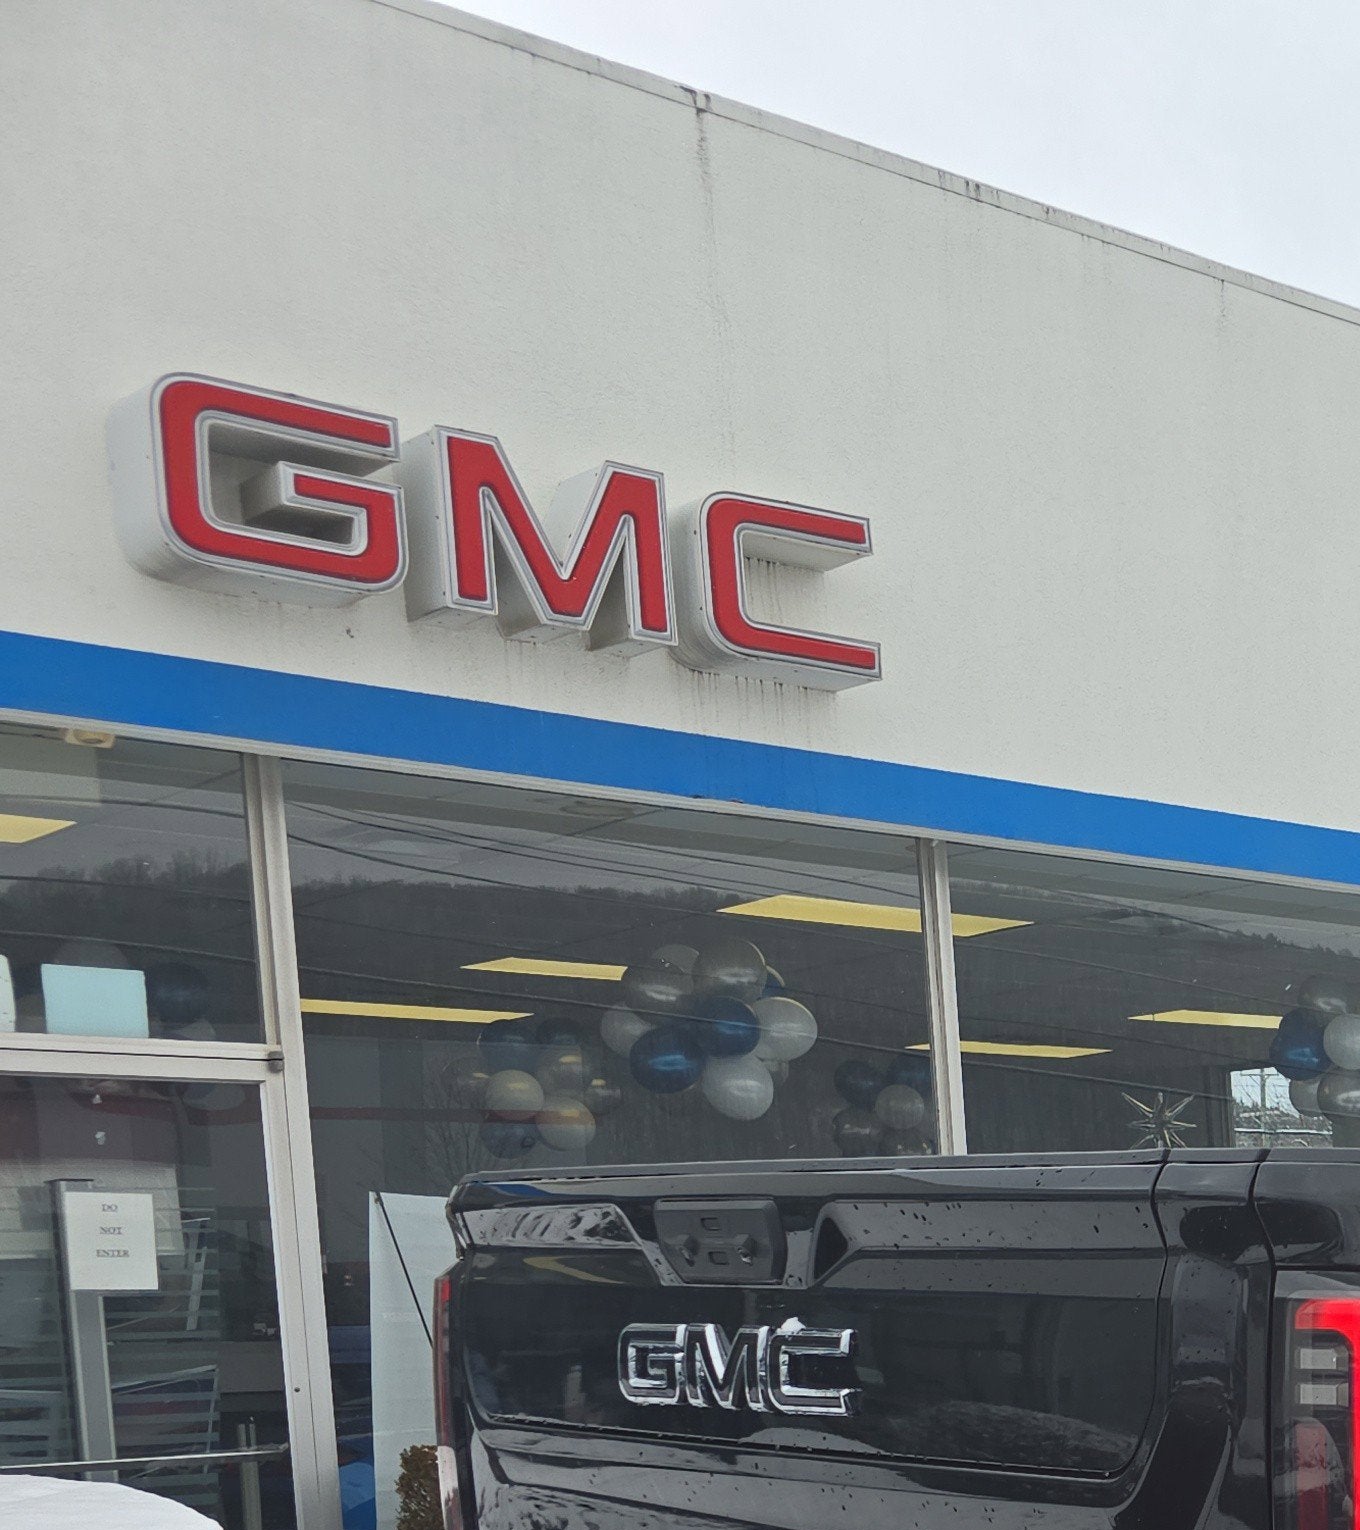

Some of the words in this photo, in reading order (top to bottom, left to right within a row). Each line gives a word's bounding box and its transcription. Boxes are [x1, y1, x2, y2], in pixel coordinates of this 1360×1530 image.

[152, 371, 883, 682] GMC
[101, 1203, 118, 1212] DO
[99, 1226, 122, 1236] NOT
[96, 1249, 129, 1259] ENTER
[617, 1322, 858, 1416] GMC
